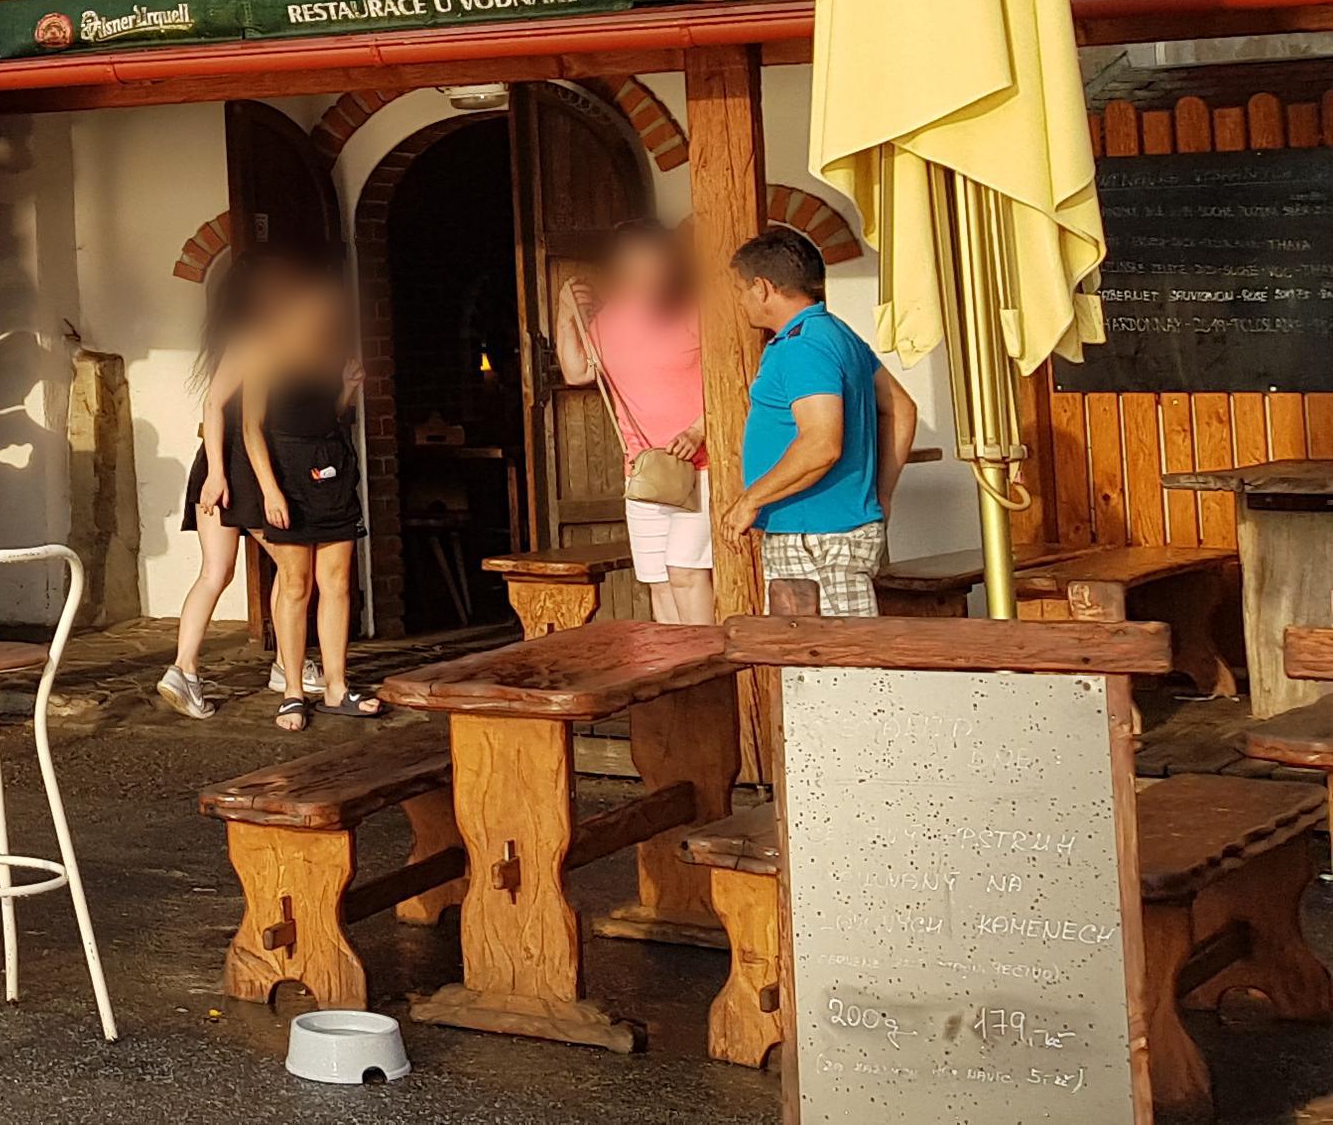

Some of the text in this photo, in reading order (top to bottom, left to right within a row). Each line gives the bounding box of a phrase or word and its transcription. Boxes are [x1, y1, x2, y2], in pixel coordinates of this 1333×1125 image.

[955, 827, 1077, 855] PSTRUH
[986, 874, 1023, 893] NA
[976, 914, 1118, 945] KAMENECH
